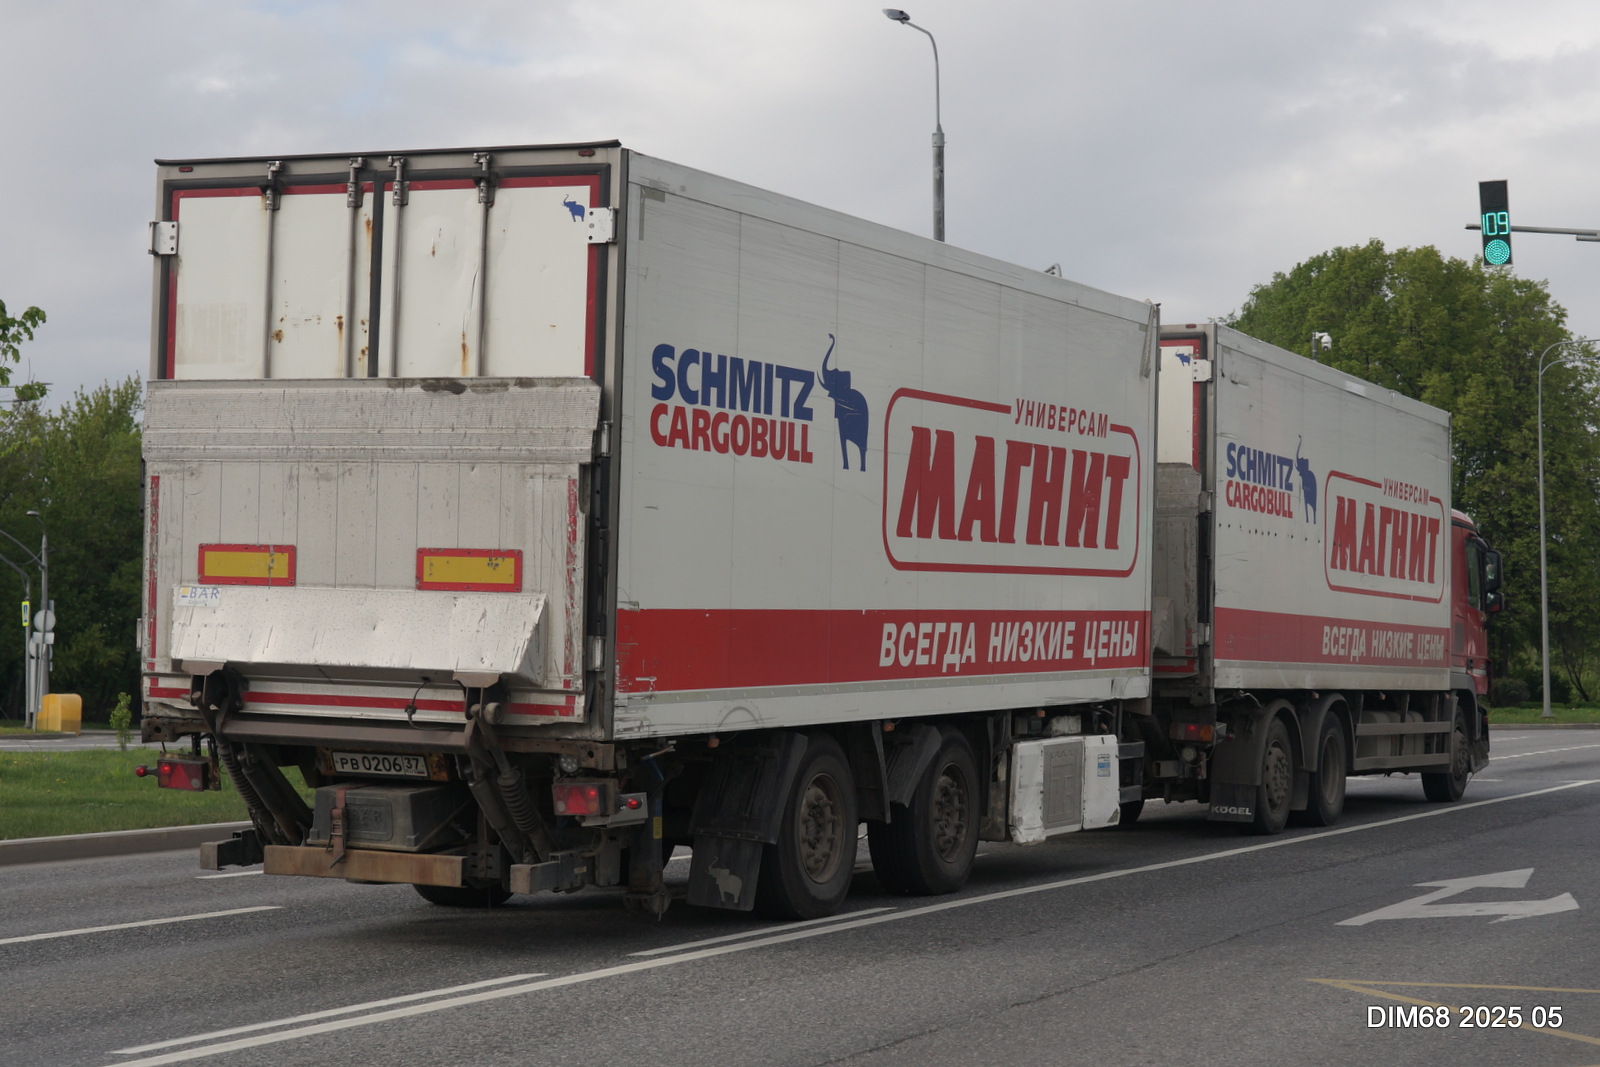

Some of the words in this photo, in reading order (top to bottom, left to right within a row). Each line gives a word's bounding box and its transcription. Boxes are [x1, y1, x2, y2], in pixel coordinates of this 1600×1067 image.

[1481, 211, 1509, 236] 109
[651, 343, 815, 422] SCHMITZ
[650, 403, 813, 464] CARGOBULL
[1014, 398, 1108, 439] УНИВЕРСАМ
[896, 425, 1131, 551] МАГНИТ
[1226, 442, 1293, 492] SCHMITZ
[1225, 480, 1293, 519] CARGOBULL
[1383, 477, 1430, 506] УНИВЕРСАМ
[1330, 495, 1440, 584] МАГНИТ
[879, 621, 976, 673] ВСЕГДА
[987, 620, 1075, 664] НИЗКИЕ
[1082, 619, 1139, 666] ЦЕНЫ
[1323, 626, 1366, 661] ВСЕГДА
[1372, 630, 1414, 660] НИЗКИЕ
[1417, 634, 1444, 665] ЦЕНЫ
[403, 757, 419, 770] 37
